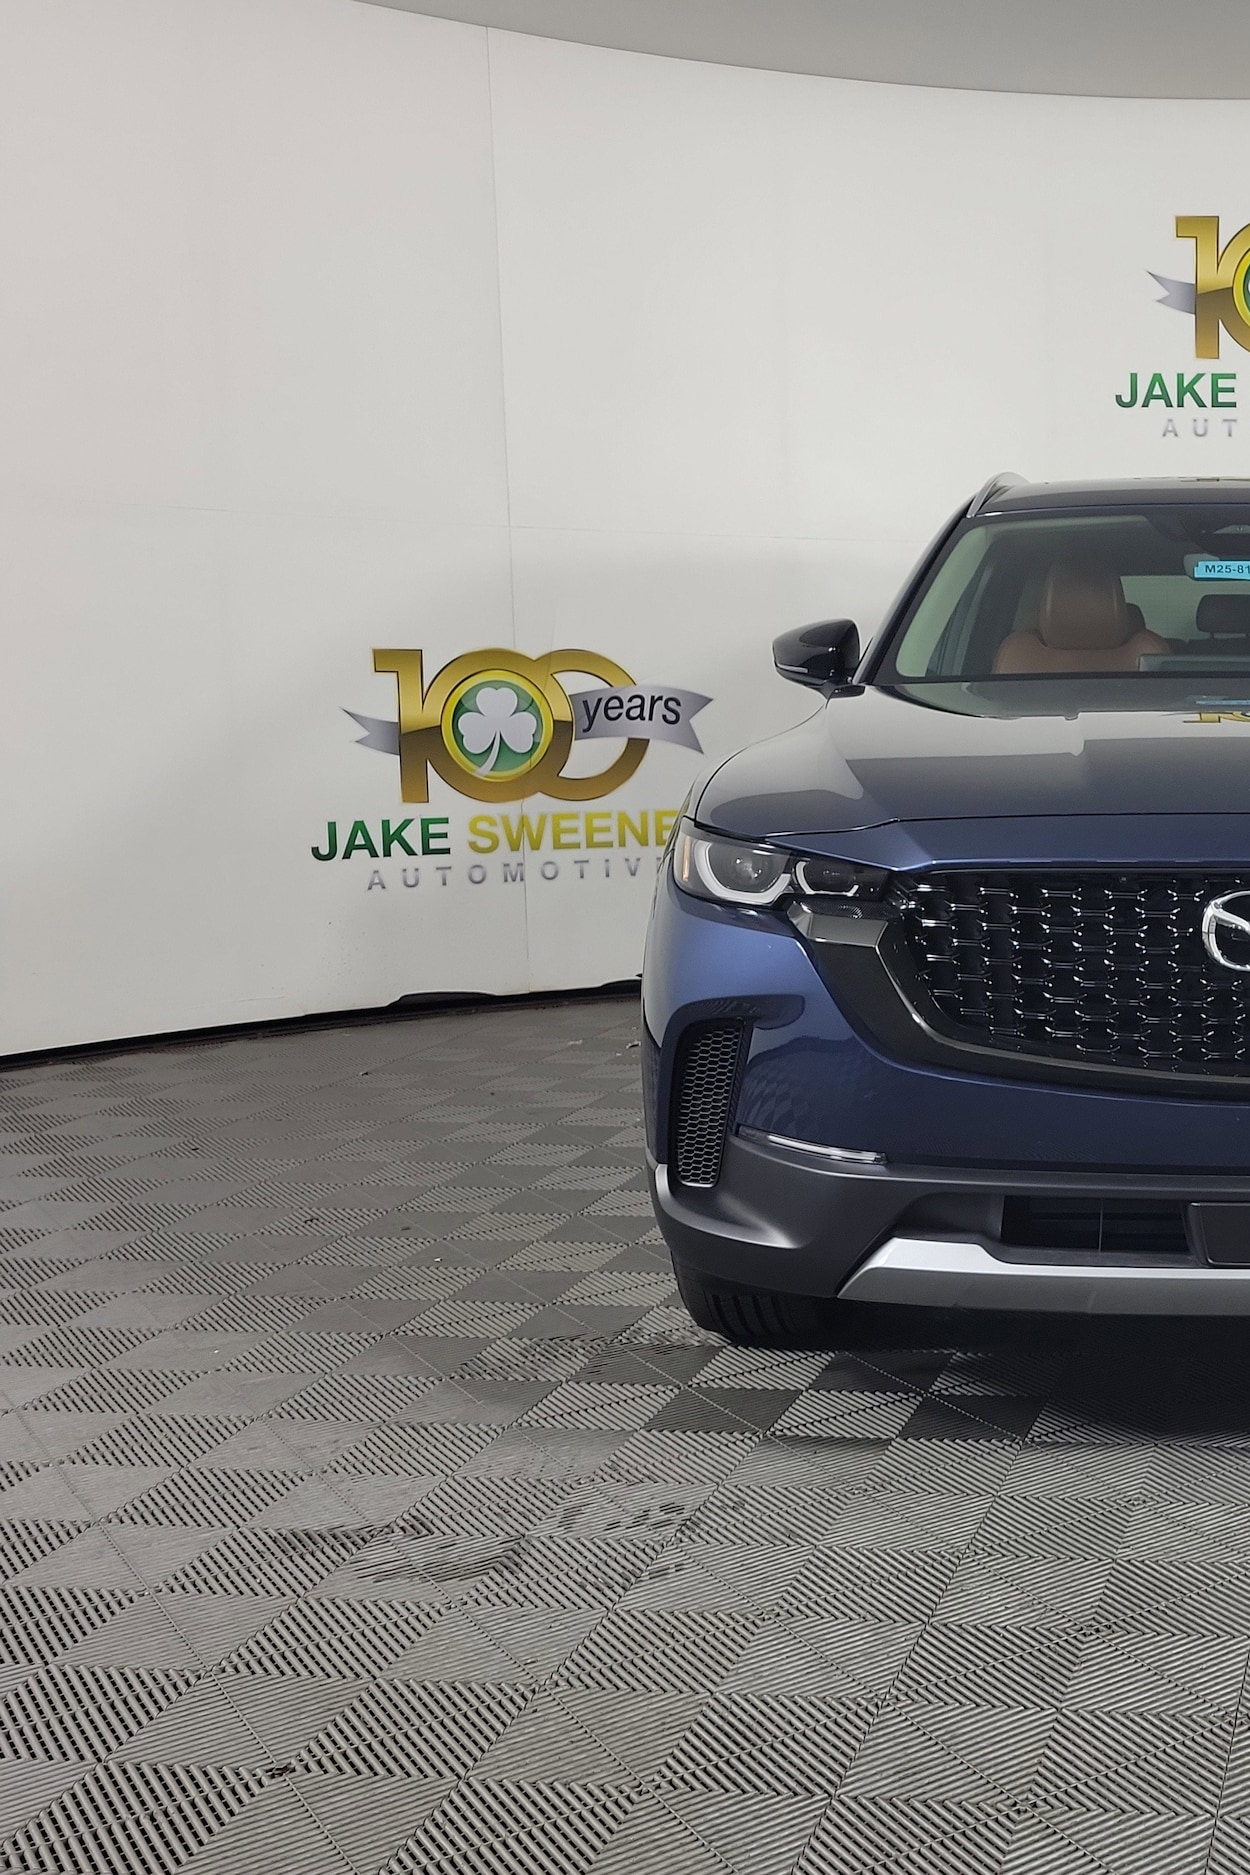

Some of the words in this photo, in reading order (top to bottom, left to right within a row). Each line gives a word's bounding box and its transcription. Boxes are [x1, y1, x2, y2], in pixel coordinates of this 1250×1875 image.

[1115, 371, 1237, 409] JAKE
[372, 647, 650, 803] 100
[582, 693, 682, 733] years
[311, 816, 451, 862] JAKE
[468, 809, 680, 855] SWEENE
[367, 856, 661, 892] AUTOMOTIV
